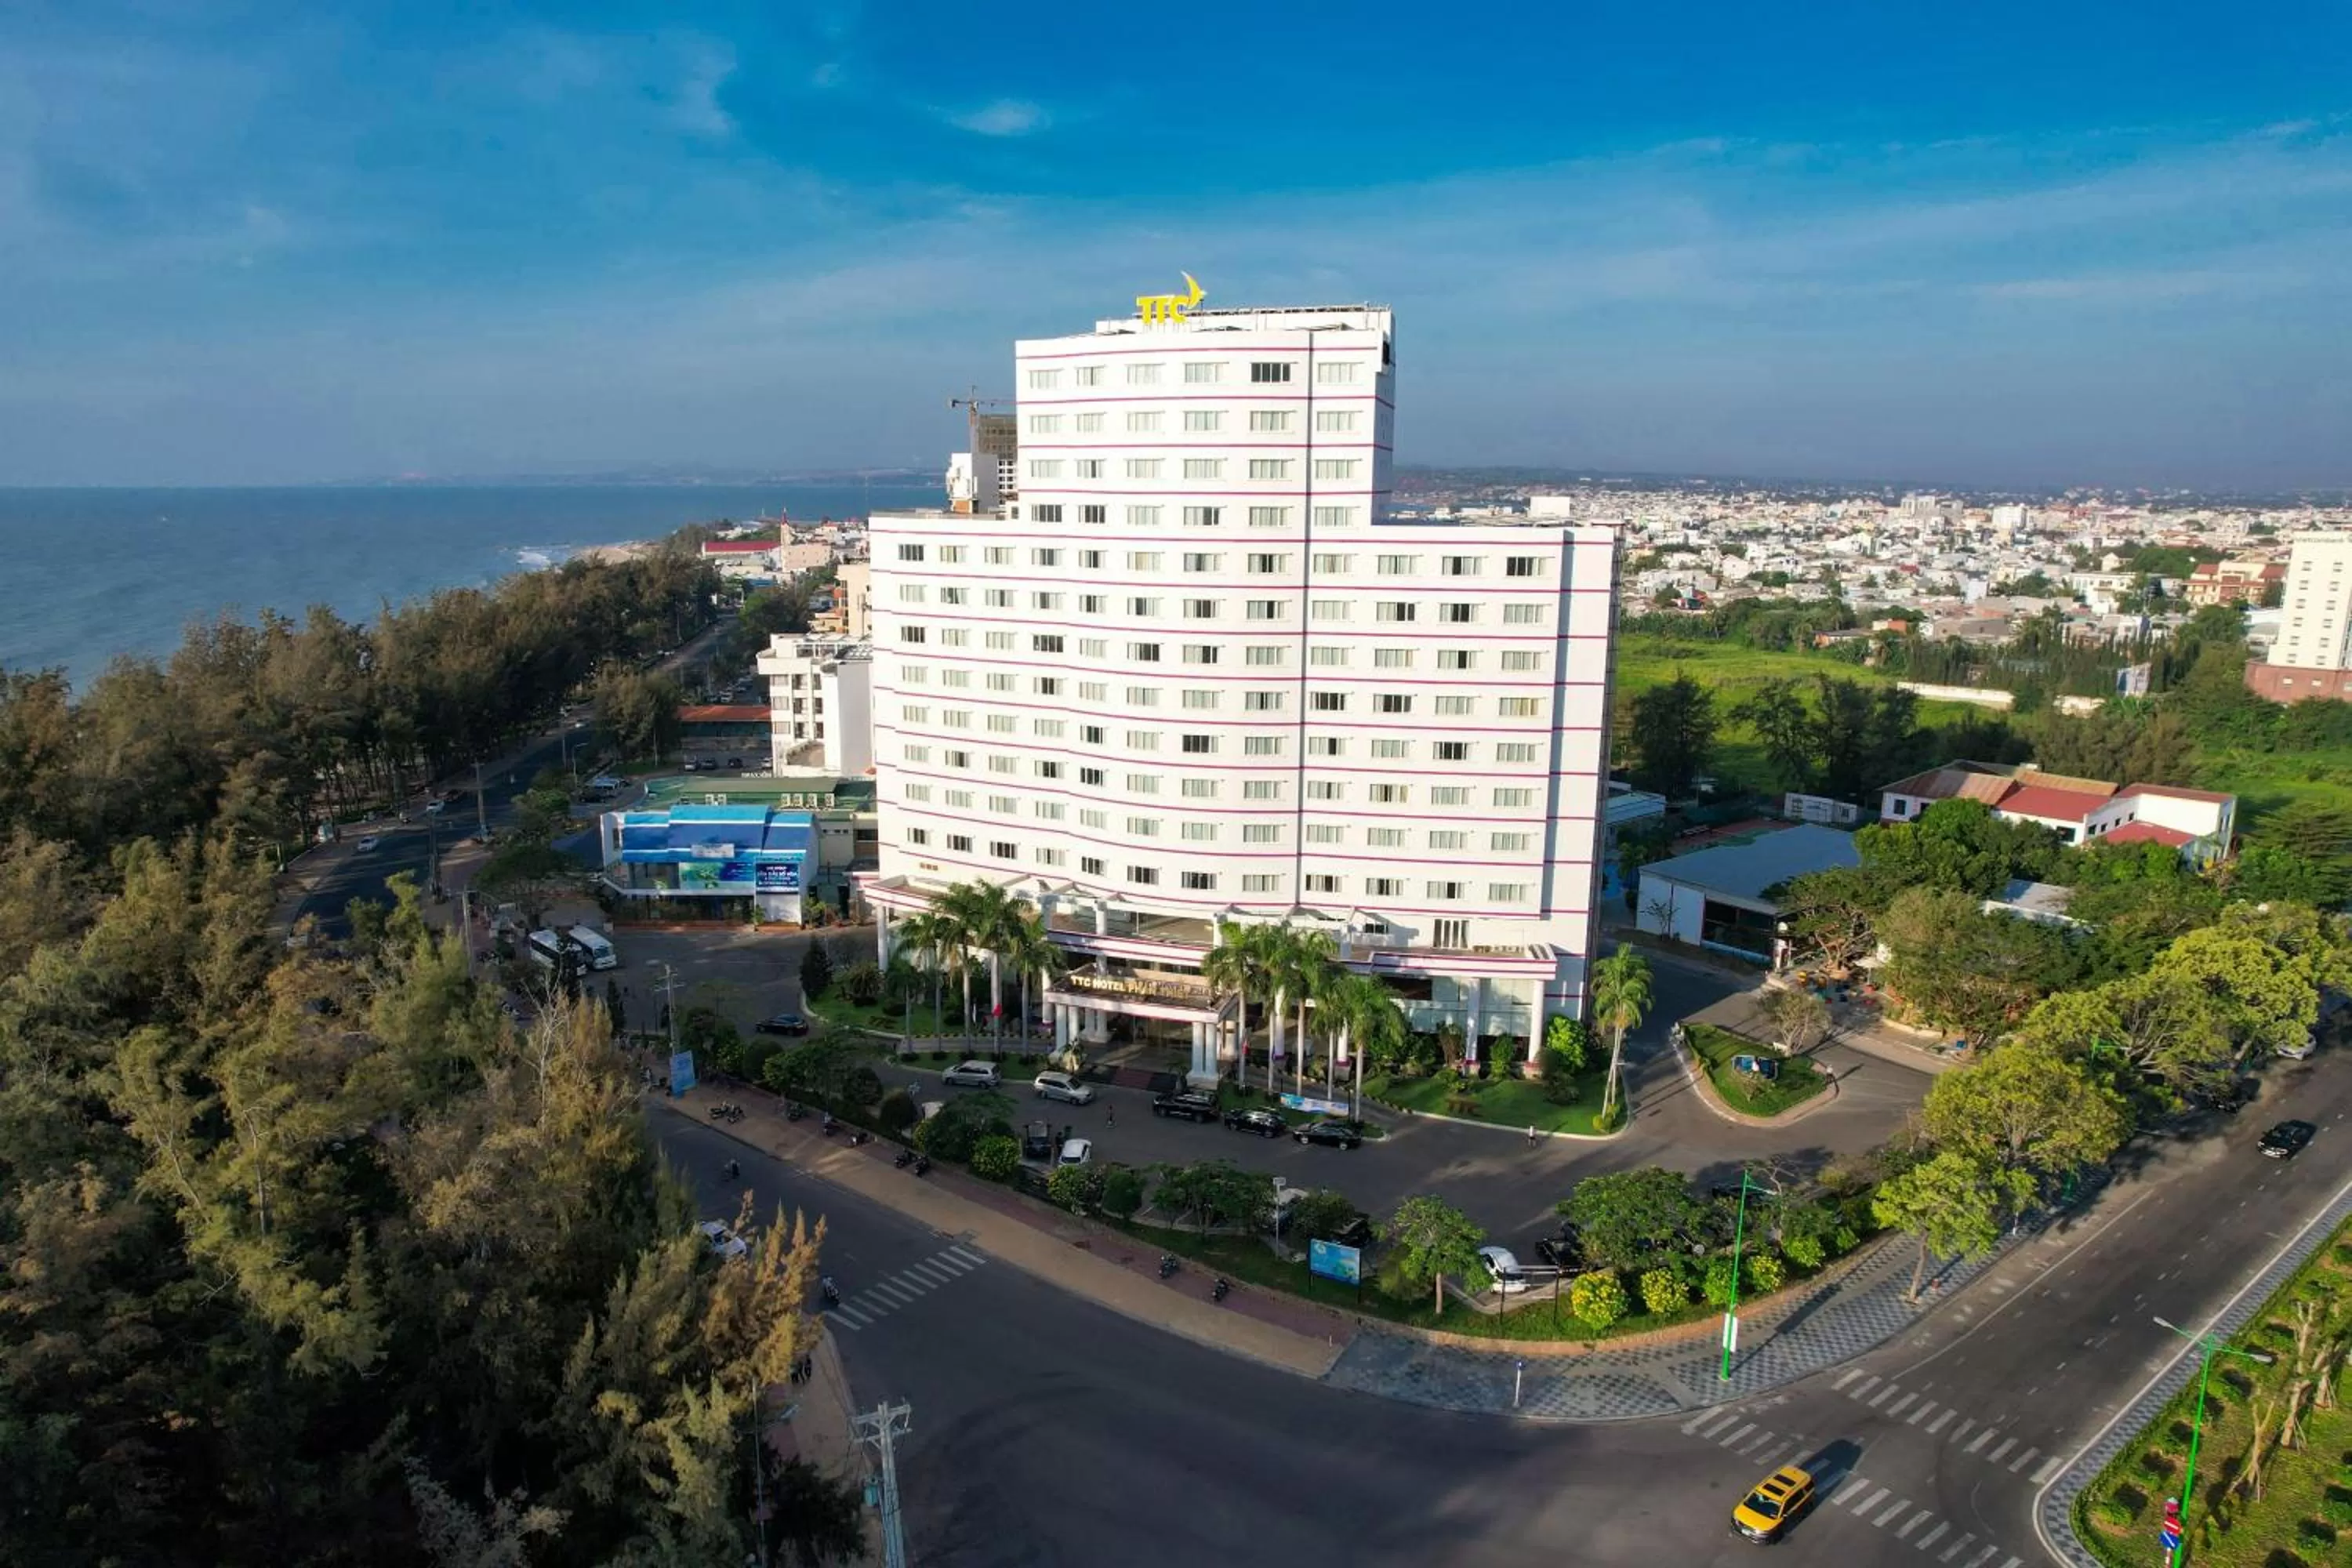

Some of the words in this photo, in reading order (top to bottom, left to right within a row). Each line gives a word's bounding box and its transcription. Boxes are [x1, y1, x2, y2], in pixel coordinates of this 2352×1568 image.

[1136, 293, 1189, 325] TTC
[1070, 975, 1091, 987] TTC
[1092, 978, 1127, 992] HOTEL
[1128, 980, 1158, 996] PHAN
